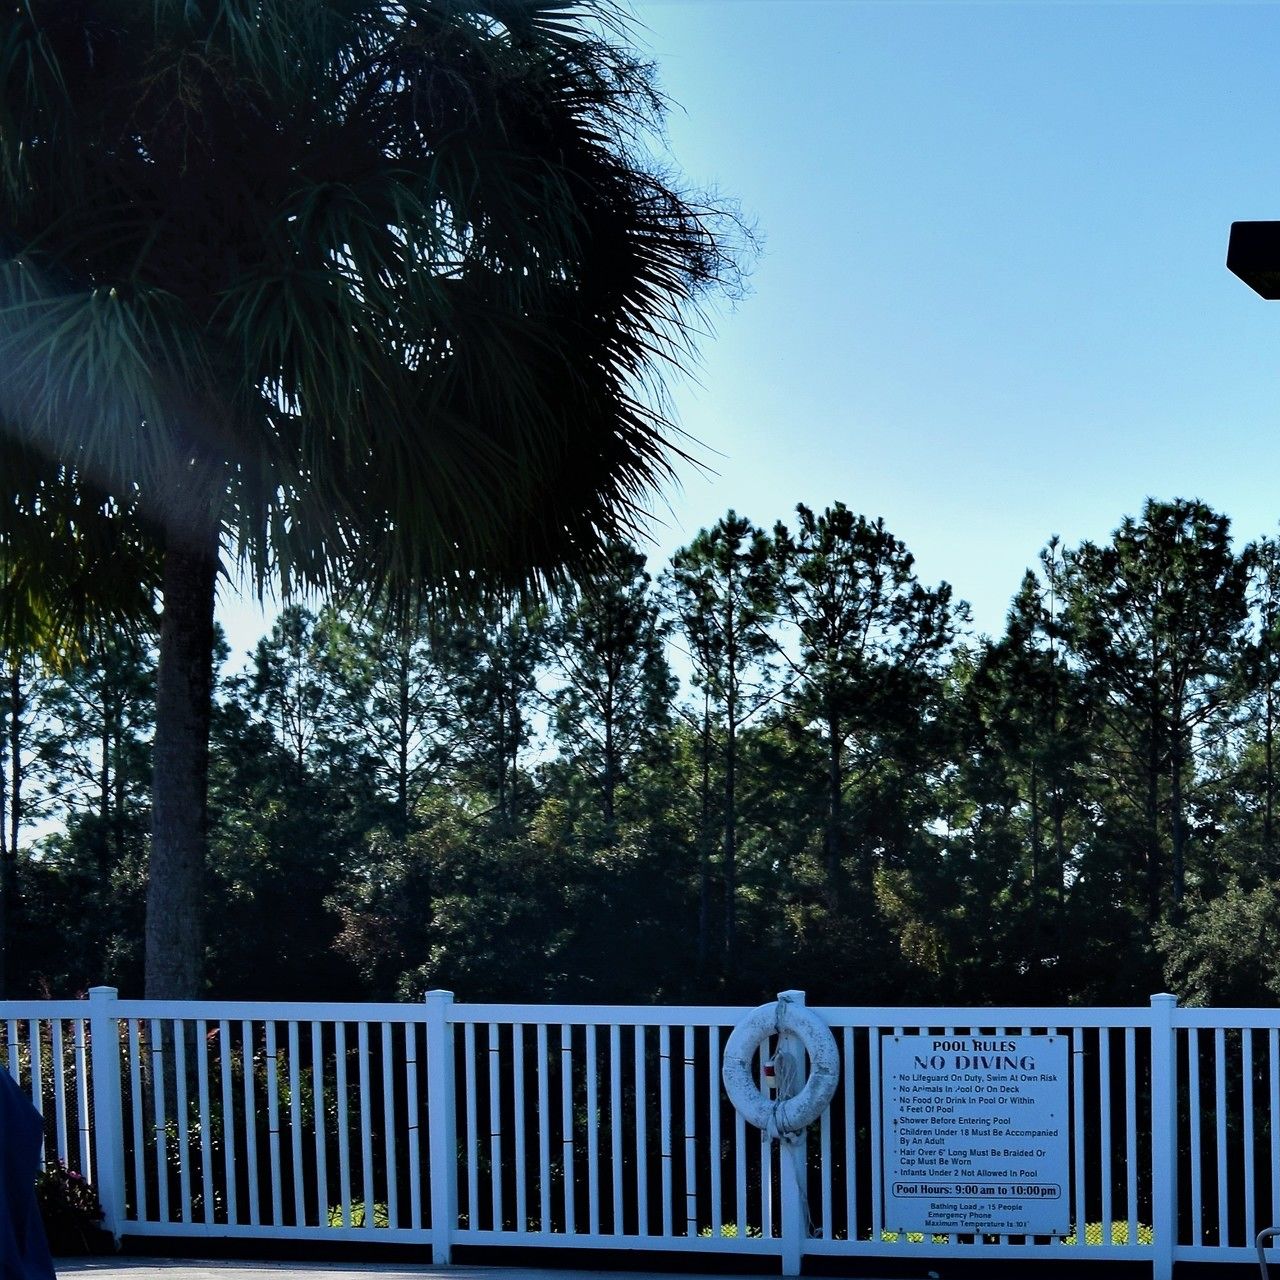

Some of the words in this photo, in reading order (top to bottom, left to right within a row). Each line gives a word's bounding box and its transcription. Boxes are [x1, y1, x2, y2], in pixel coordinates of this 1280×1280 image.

[933, 1041, 969, 1051] POOL
[974, 1041, 1016, 1051] RULES
[914, 1056, 946, 1070] NO
[955, 1056, 1035, 1070] DIVING
[913, 1074, 949, 1083] Lifeguard
[958, 1117, 991, 1126] Entering
[935, 1128, 957, 1136] Under
[1005, 1129, 1058, 1138] Accompanied
[900, 1137, 909, 1146] By
[948, 1149, 967, 1158] Long
[1003, 1149, 1034, 1157] Braided
[900, 1158, 916, 1166] Cap
[896, 1185, 918, 1194] Pool
[920, 1185, 952, 1194] Hours:
[955, 1185, 978, 1194] 9:00
[998, 1186, 1007, 1194] to
[1011, 1186, 1040, 1195] 10:00
[1041, 1187, 1056, 1197] pm
[930, 1203, 958, 1211] Bathing
[960, 1221, 1004, 1229] Temperature
